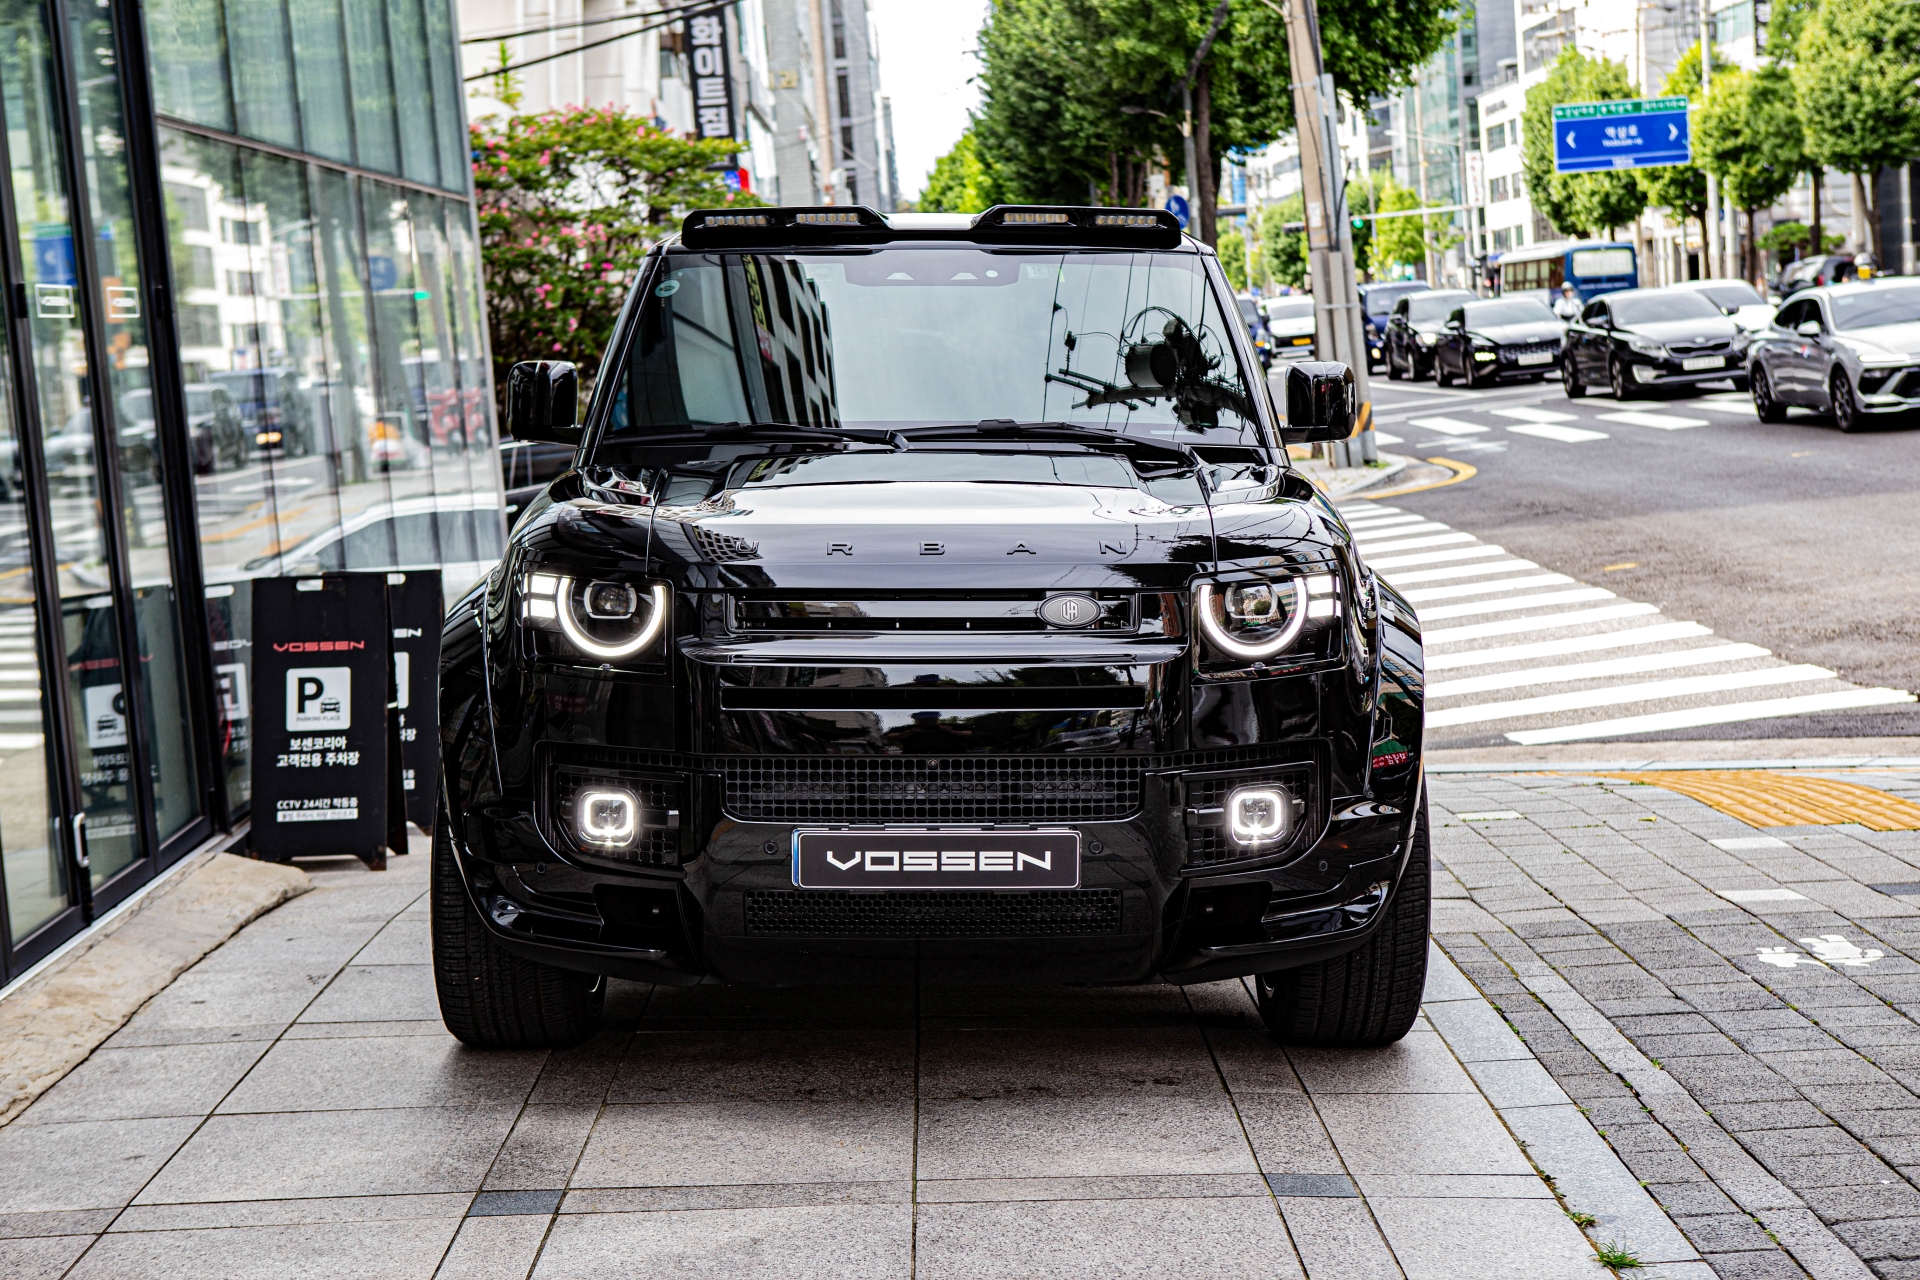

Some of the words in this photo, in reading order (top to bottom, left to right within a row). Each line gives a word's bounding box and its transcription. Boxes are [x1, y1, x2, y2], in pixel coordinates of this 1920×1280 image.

[735, 541, 1127, 556] URBAN
[273, 640, 365, 652] VOSSEN
[297, 677, 324, 714] P
[289, 735, 348, 752] 보센코리아
[276, 753, 323, 768] 고객전용
[324, 751, 360, 767] 주차장
[276, 800, 302, 810] CCTV
[302, 797, 331, 809] 24시간
[826, 851, 1052, 872] VOSSEN
